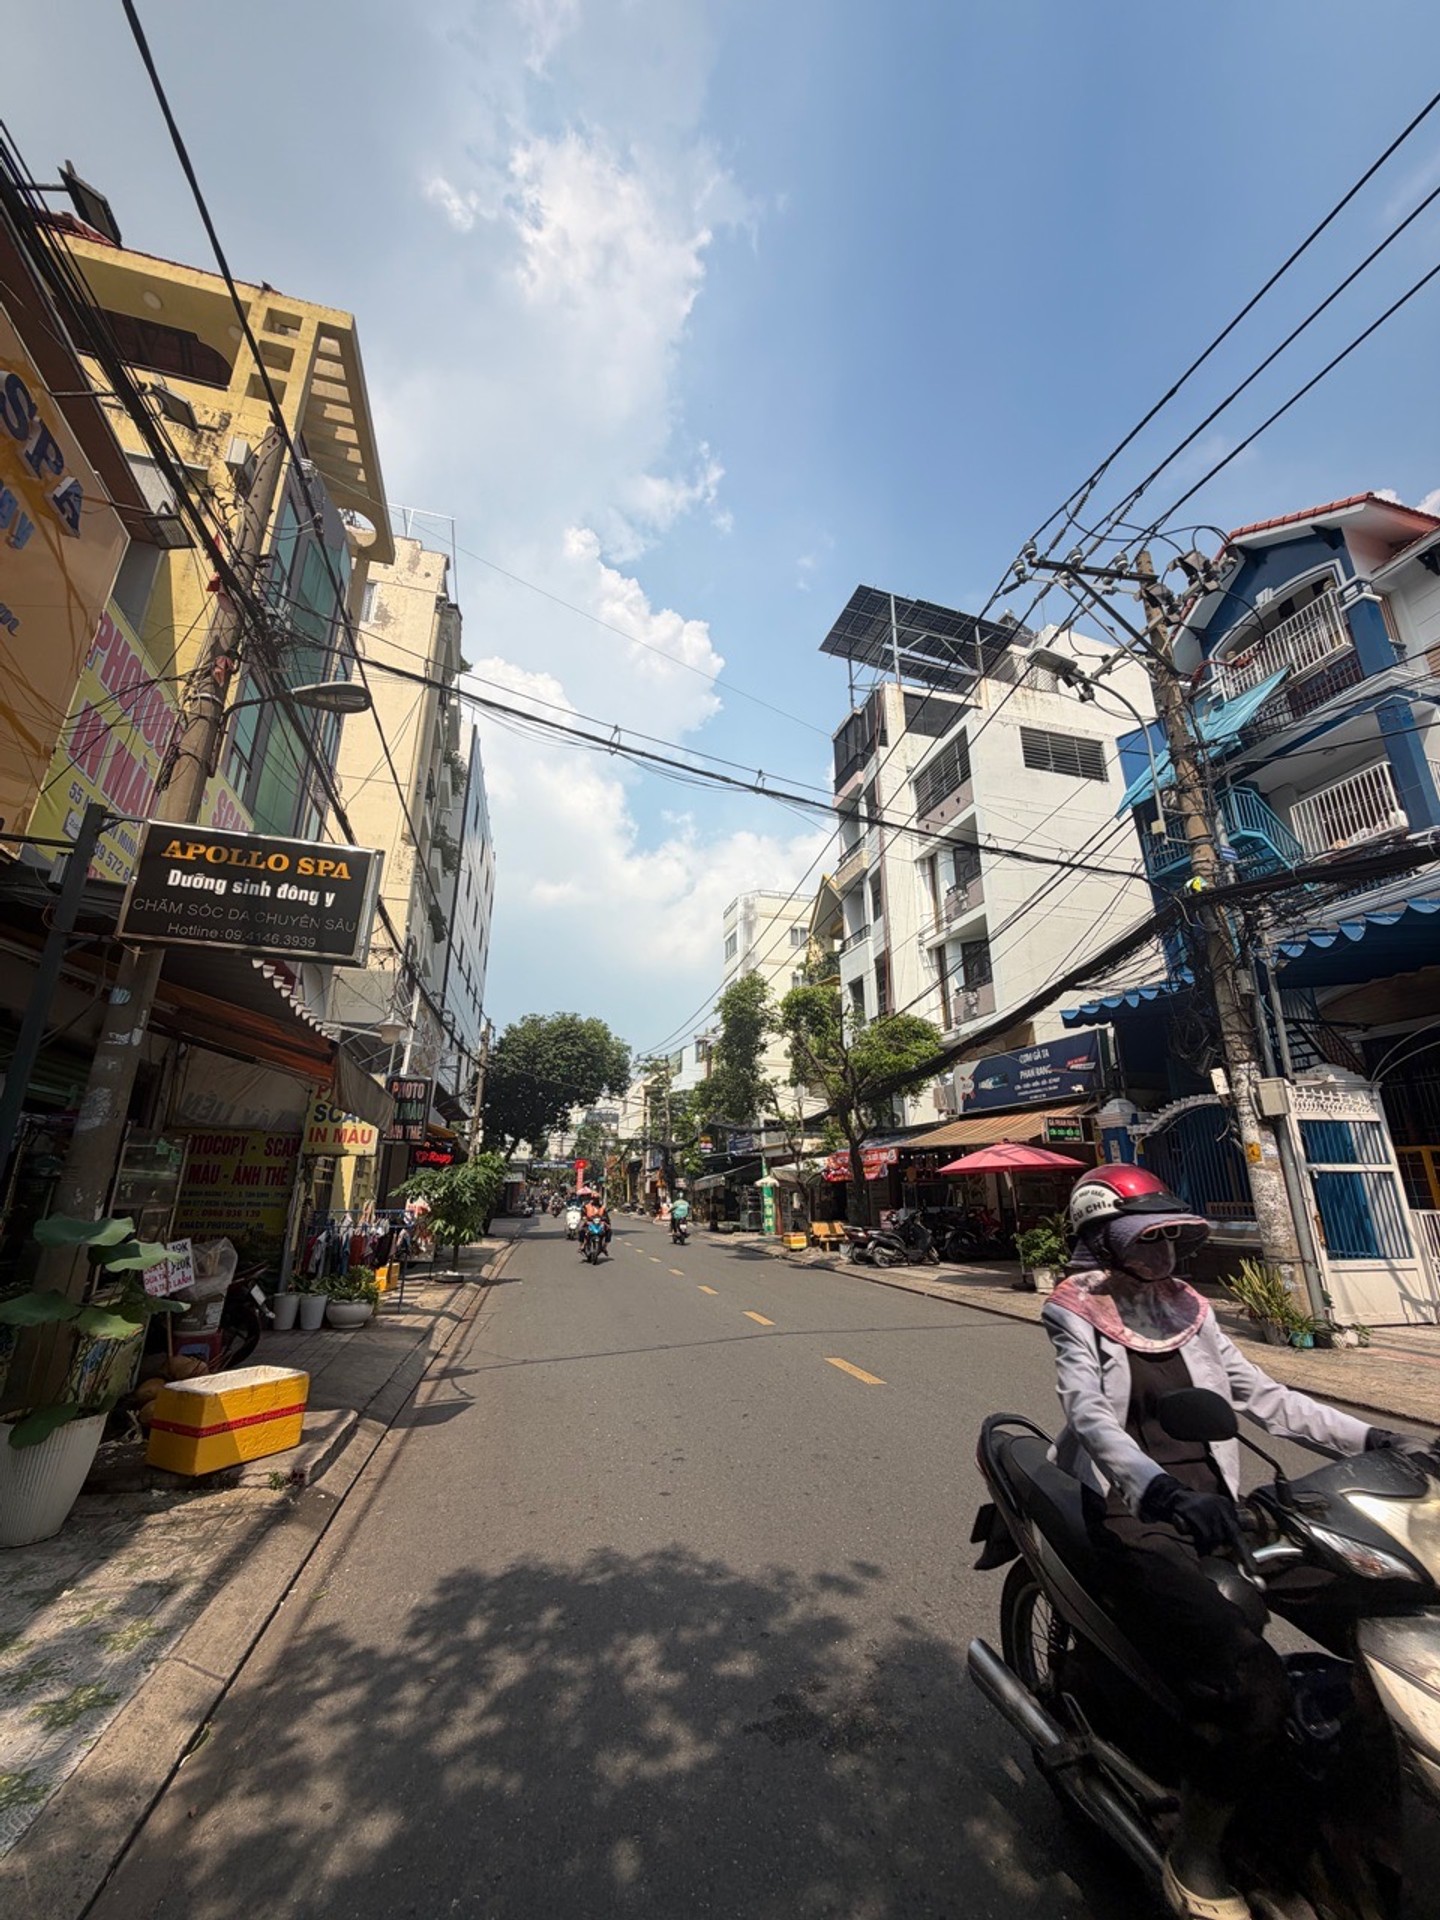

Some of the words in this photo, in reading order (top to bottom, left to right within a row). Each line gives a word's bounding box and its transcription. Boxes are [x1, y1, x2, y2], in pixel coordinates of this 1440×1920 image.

[69, 701, 113, 786] IN
[69, 781, 83, 805] 55
[105, 851, 124, 876] 572
[161, 840, 290, 872] APOLLO
[296, 857, 351, 880] SPA
[167, 869, 227, 895] Dưỡng
[232, 878, 272, 898] sinh
[276, 882, 320, 906] đông
[324, 891, 336, 908] y
[132, 898, 183, 915] CHĂM
[187, 902, 224, 918] SÓC
[228, 908, 250, 920] DA
[254, 911, 320, 930] CHUYÊN
[324, 918, 357, 933] SÂU
[392, 1081, 425, 1099] PHOTO
[308, 1127, 328, 1143] IN
[332, 1125, 373, 1145] MÀU
